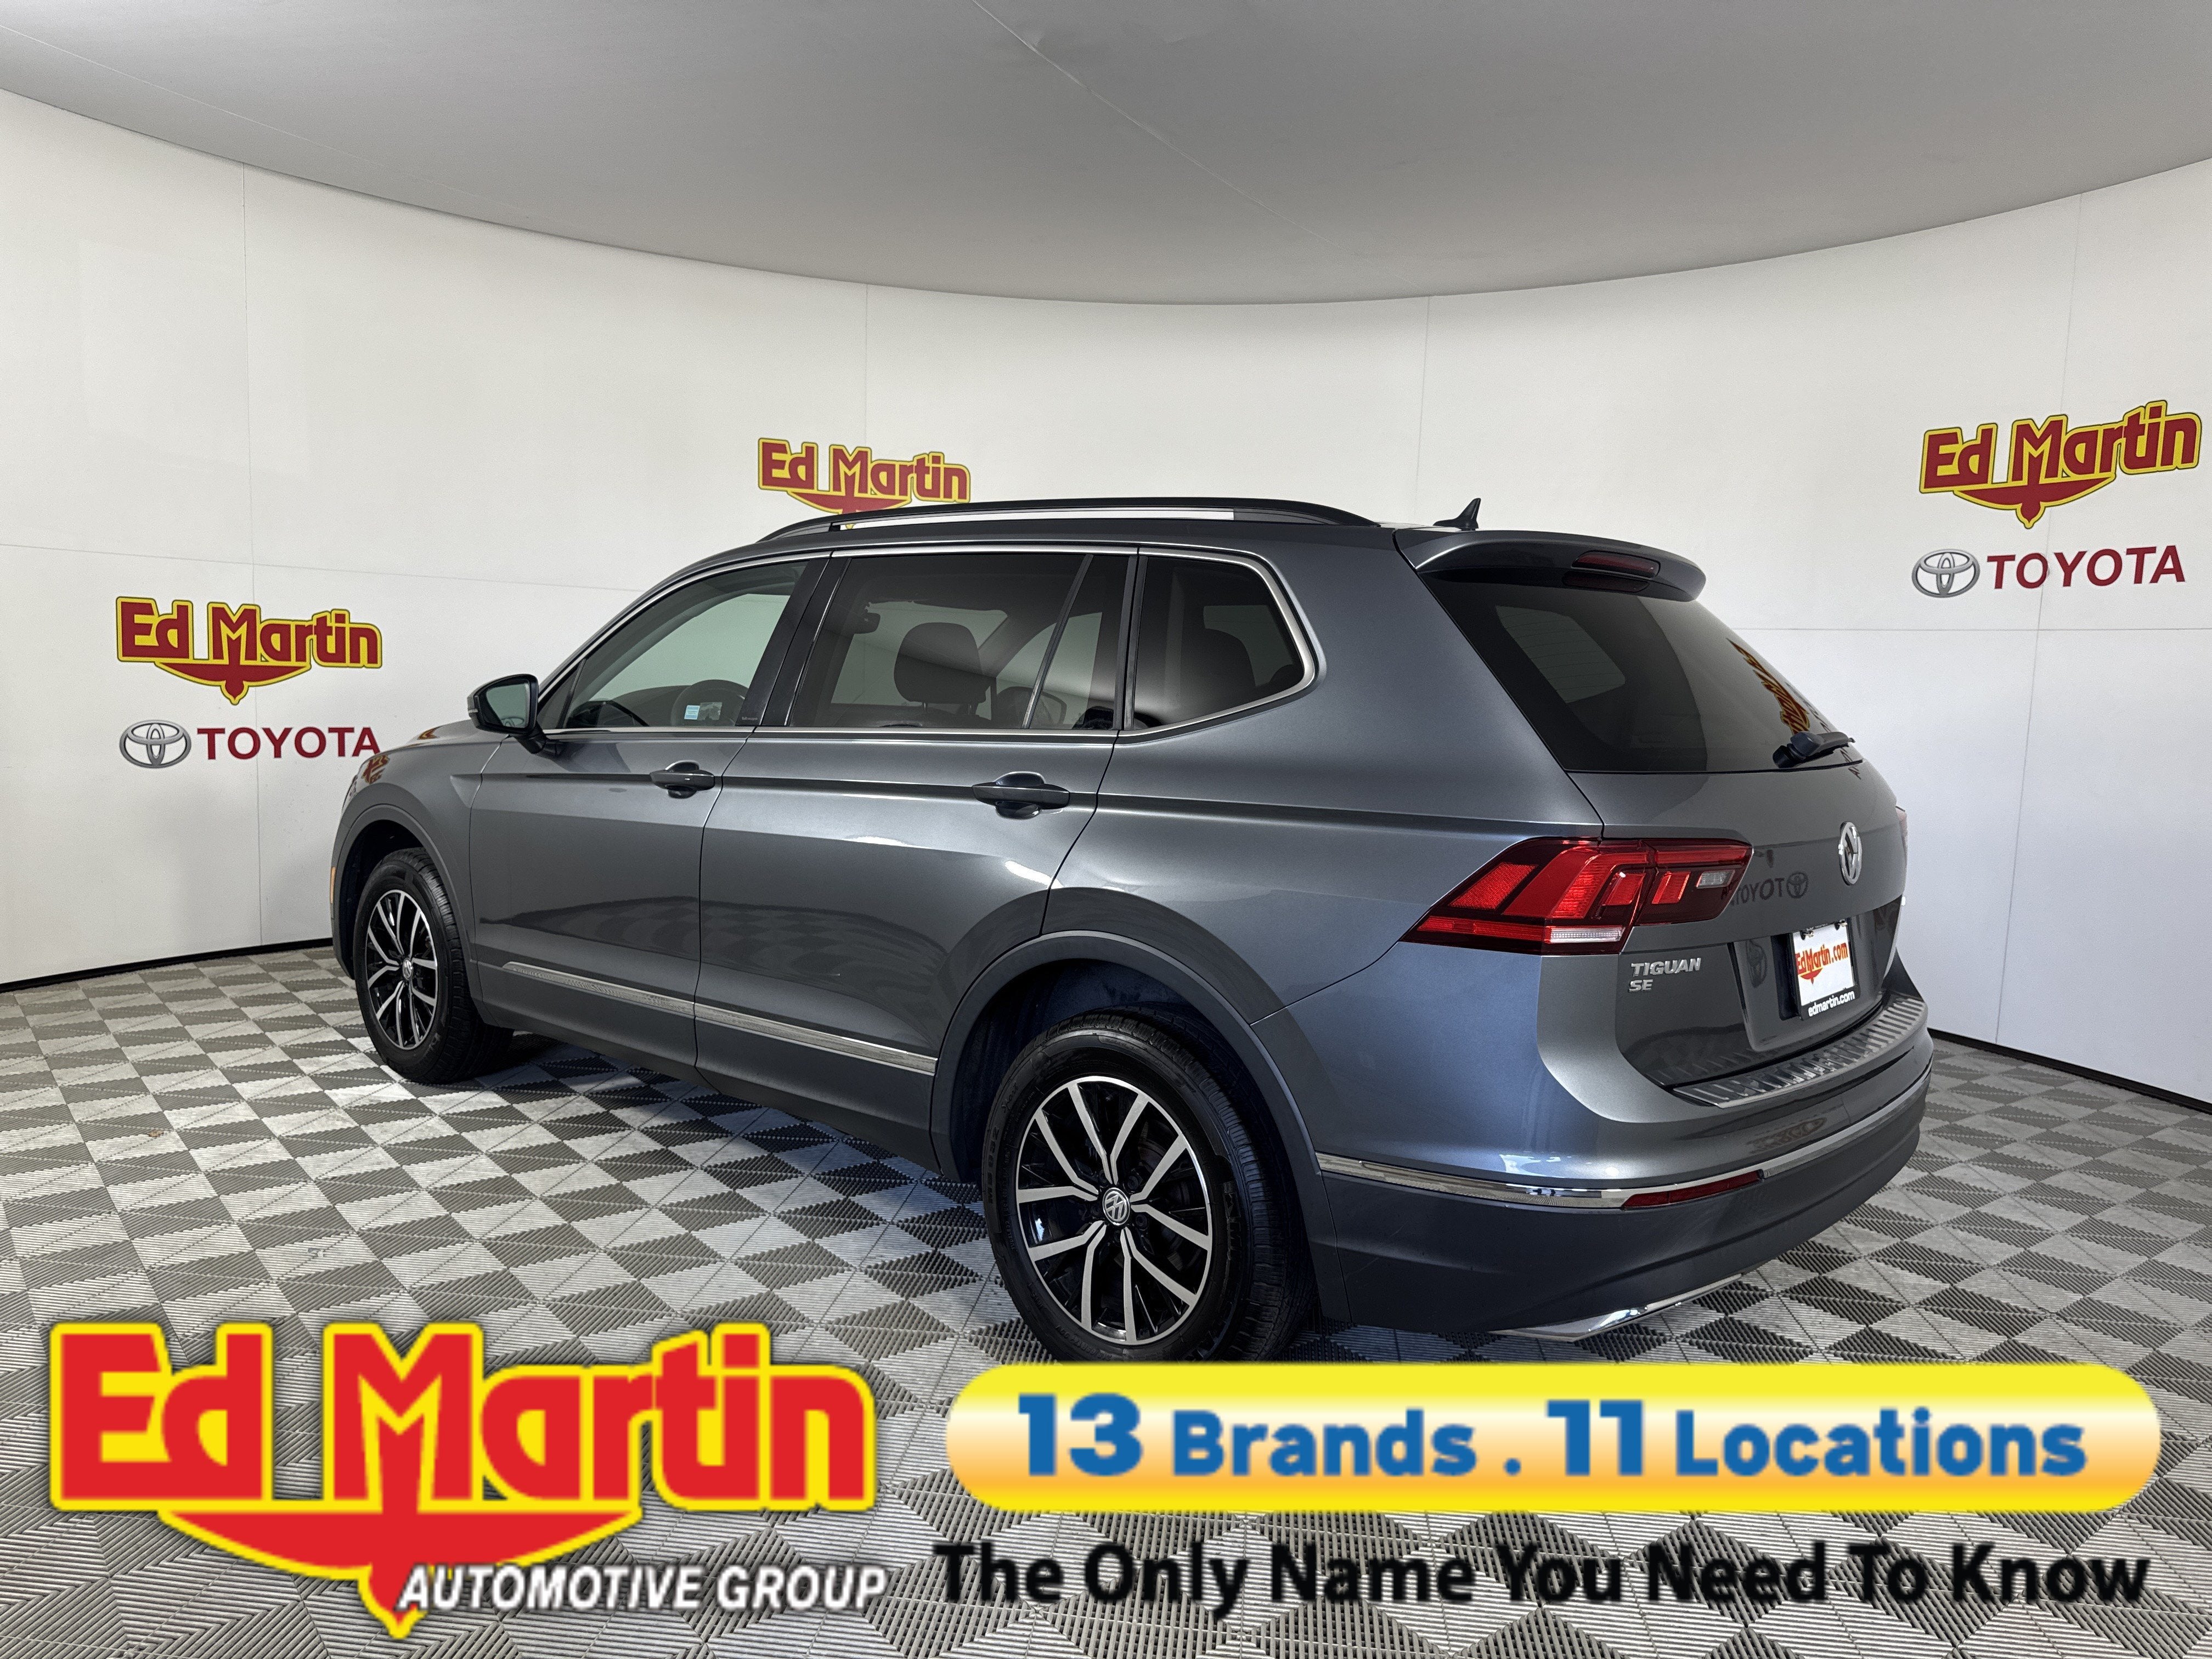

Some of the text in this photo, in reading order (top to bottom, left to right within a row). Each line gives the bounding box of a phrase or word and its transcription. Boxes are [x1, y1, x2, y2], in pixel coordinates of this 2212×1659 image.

[1923, 405, 2198, 489] Ed Martin
[761, 442, 969, 501] Ed Martin
[1987, 545, 2186, 589] TOYOTA
[120, 601, 380, 665] Ed Martin
[197, 727, 381, 760] TOYOTA
[1628, 979, 1653, 992] SE
[1630, 957, 1701, 978] TIGUAN
[1808, 990, 1855, 1017] edmartin.com
